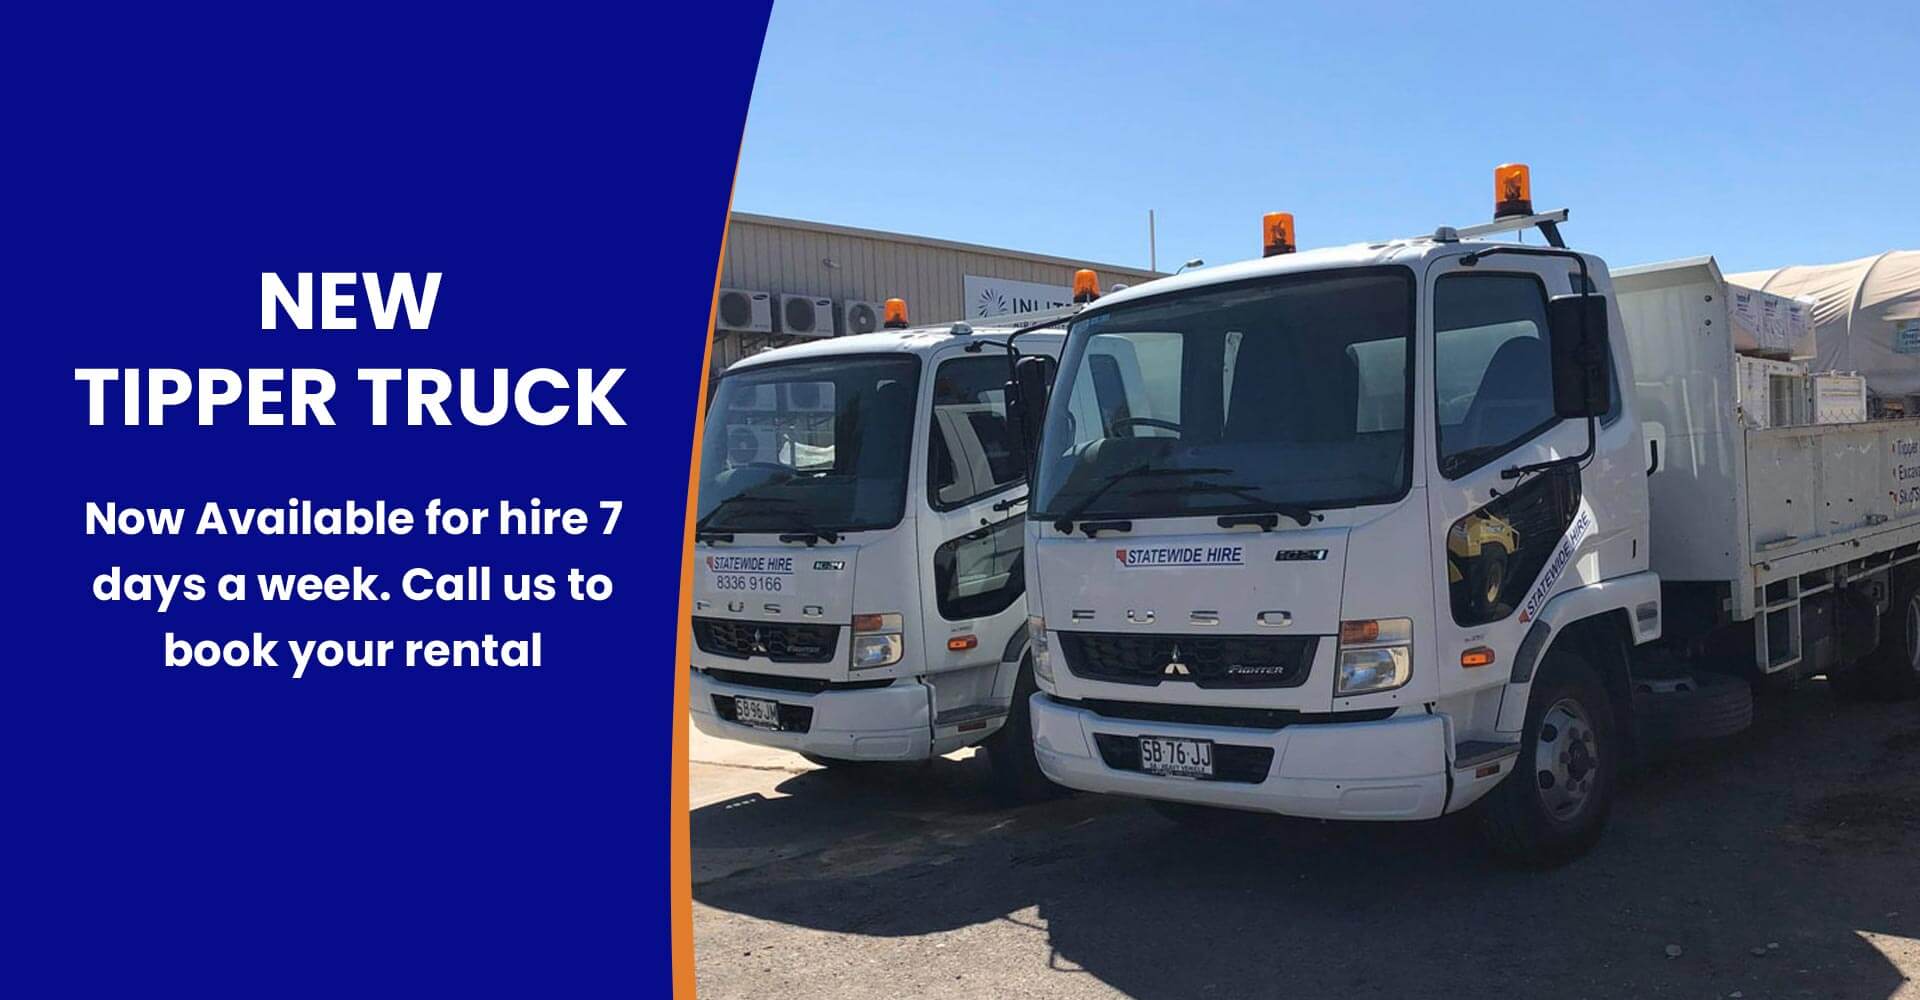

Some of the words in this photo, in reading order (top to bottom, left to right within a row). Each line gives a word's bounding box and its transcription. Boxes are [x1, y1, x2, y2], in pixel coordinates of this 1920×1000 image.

[714, 556, 765, 570] STATEWIDE
[767, 558, 793, 571] HIRE
[1128, 548, 1202, 564] STATEWIDE
[1207, 547, 1242, 562] HIRE
[1527, 541, 1572, 616] STATEWIDE
[1569, 511, 1589, 544] HIRE
[717, 575, 746, 590] 8336
[749, 576, 782, 591] 9166
[696, 600, 824, 617] FUSO
[1072, 610, 1293, 627] FUSO
